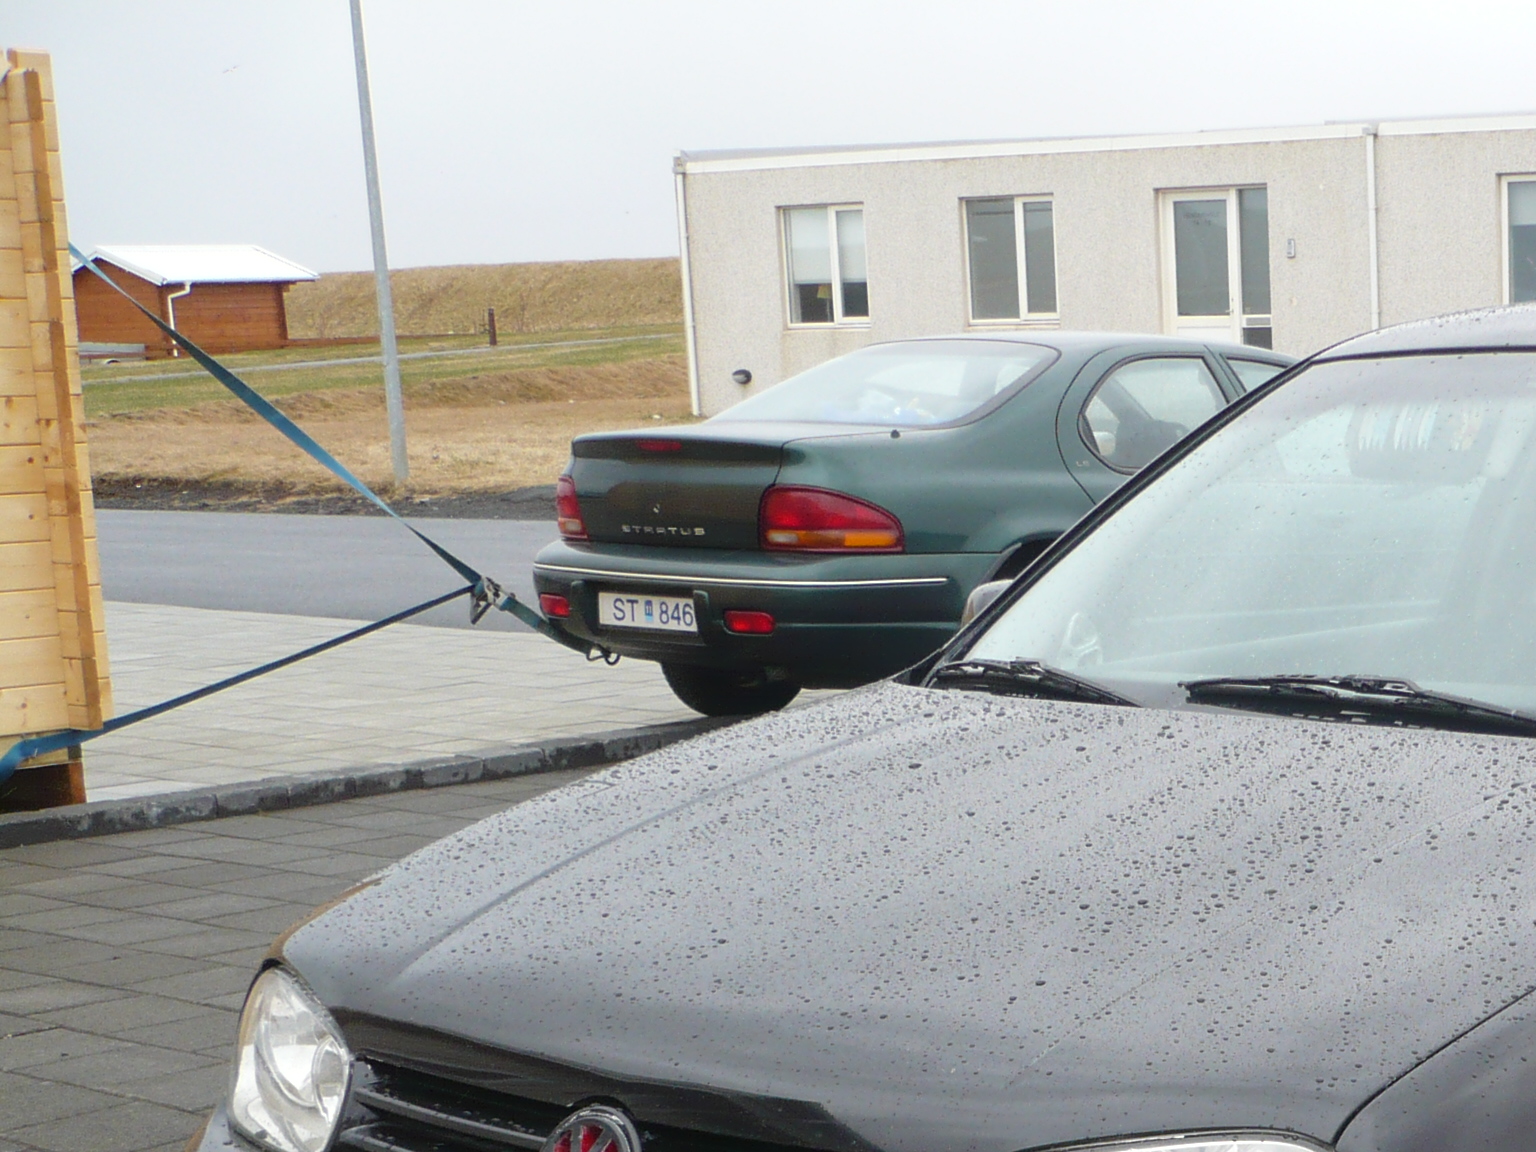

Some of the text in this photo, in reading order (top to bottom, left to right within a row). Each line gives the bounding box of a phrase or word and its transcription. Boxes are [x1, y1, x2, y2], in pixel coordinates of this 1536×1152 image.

[621, 525, 706, 536] STRATUS
[613, 598, 694, 627] ST 846
